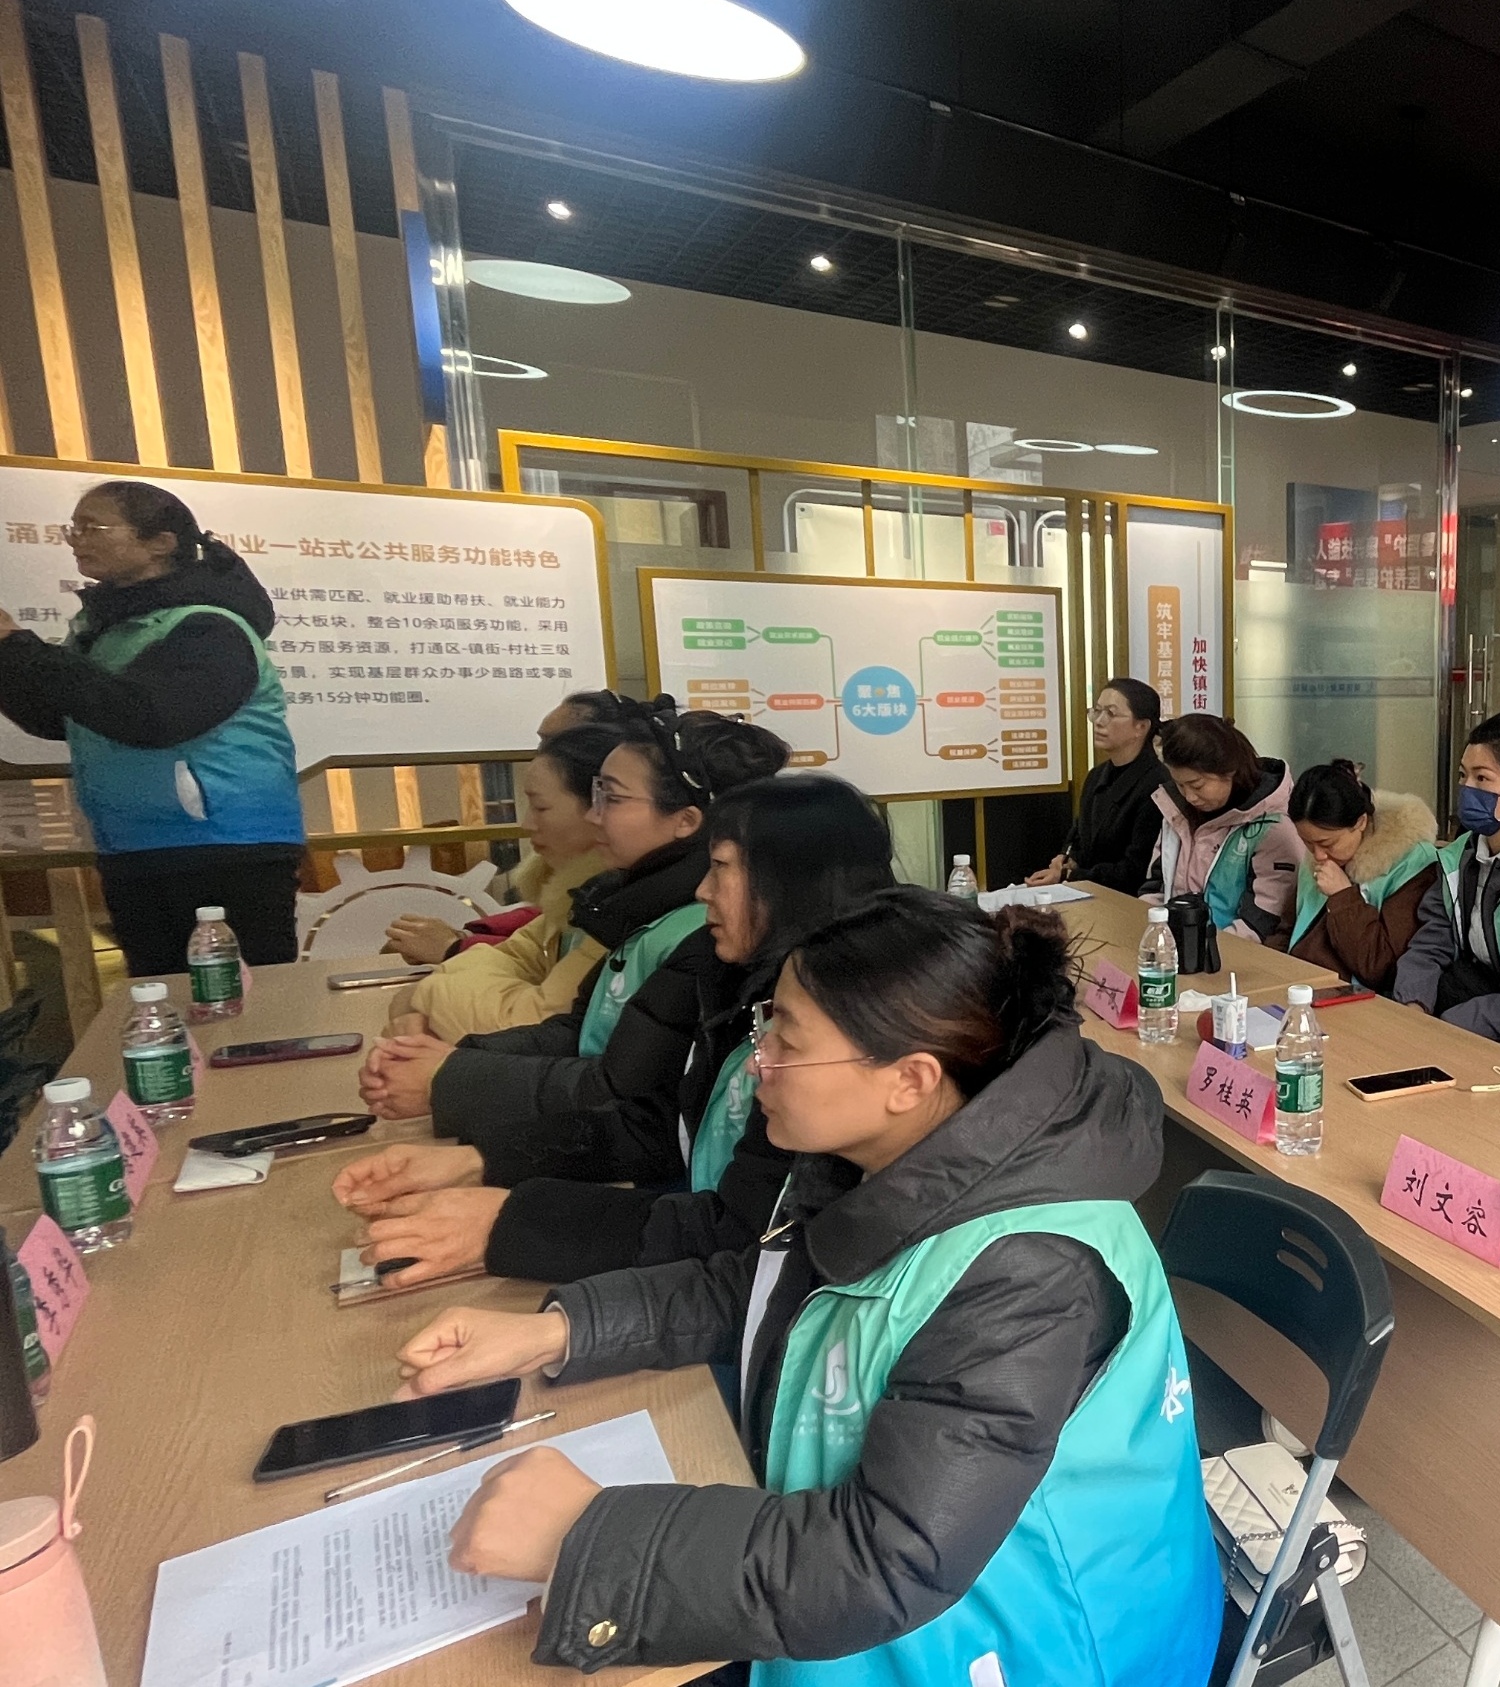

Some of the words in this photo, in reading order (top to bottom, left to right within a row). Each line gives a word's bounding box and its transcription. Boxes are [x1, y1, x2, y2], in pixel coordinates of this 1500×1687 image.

[1156, 603, 1173, 719] 筑牢基层幸福
[852, 703, 908, 717] 6大版块
[1199, 1066, 1254, 1119] 罗桂英
